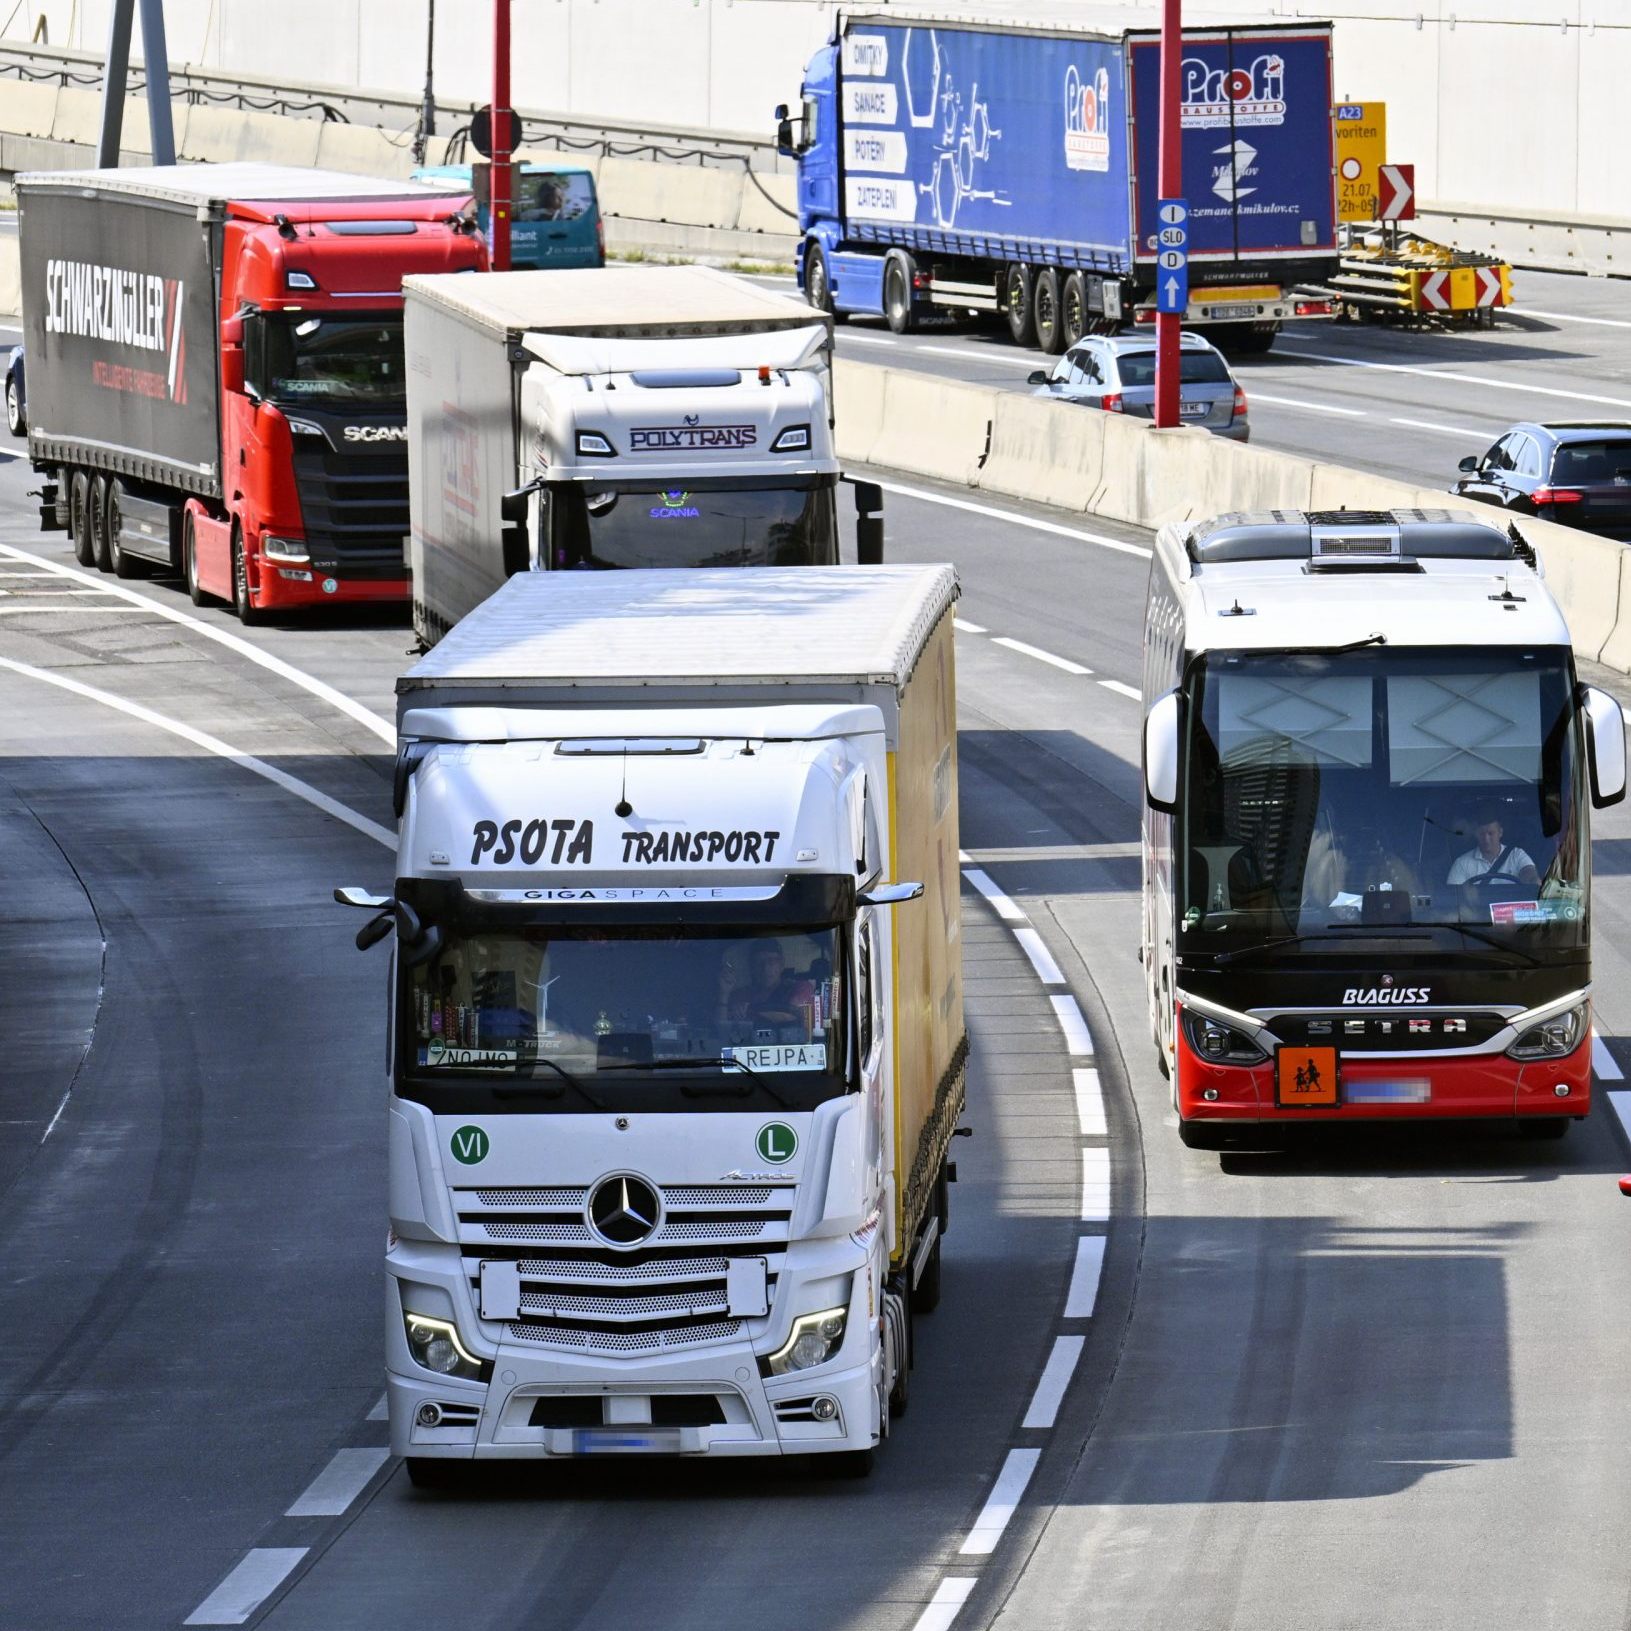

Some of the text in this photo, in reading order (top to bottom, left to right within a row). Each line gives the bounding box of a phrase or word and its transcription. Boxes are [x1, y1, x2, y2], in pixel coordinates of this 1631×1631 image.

[1181, 55, 1285, 103] Profi
[855, 91, 886, 113] SANACE
[1183, 104, 1280, 115] BAUSOFFE
[1339, 107, 1362, 119] A23
[1336, 125, 1377, 138] voriten
[1343, 184, 1371, 196] 21.07
[1163, 230, 1183, 244] SLO
[1168, 253, 1177, 267] D
[46, 259, 165, 351] SCHWARZMÜLLER
[287, 382, 329, 392] SCANIA
[343, 426, 408, 441] SCAN
[630, 427, 757, 448] POLYTRANS
[650, 507, 700, 519] SCANIA
[471, 819, 780, 865] PSOTA TRANSPORT
[1342, 987, 1431, 1004] BLAGUSS
[1307, 1018, 1467, 1035] SETRA
[747, 1048, 808, 1067] REJPA
[457, 1132, 482, 1157] VI
[767, 1130, 786, 1156] L
